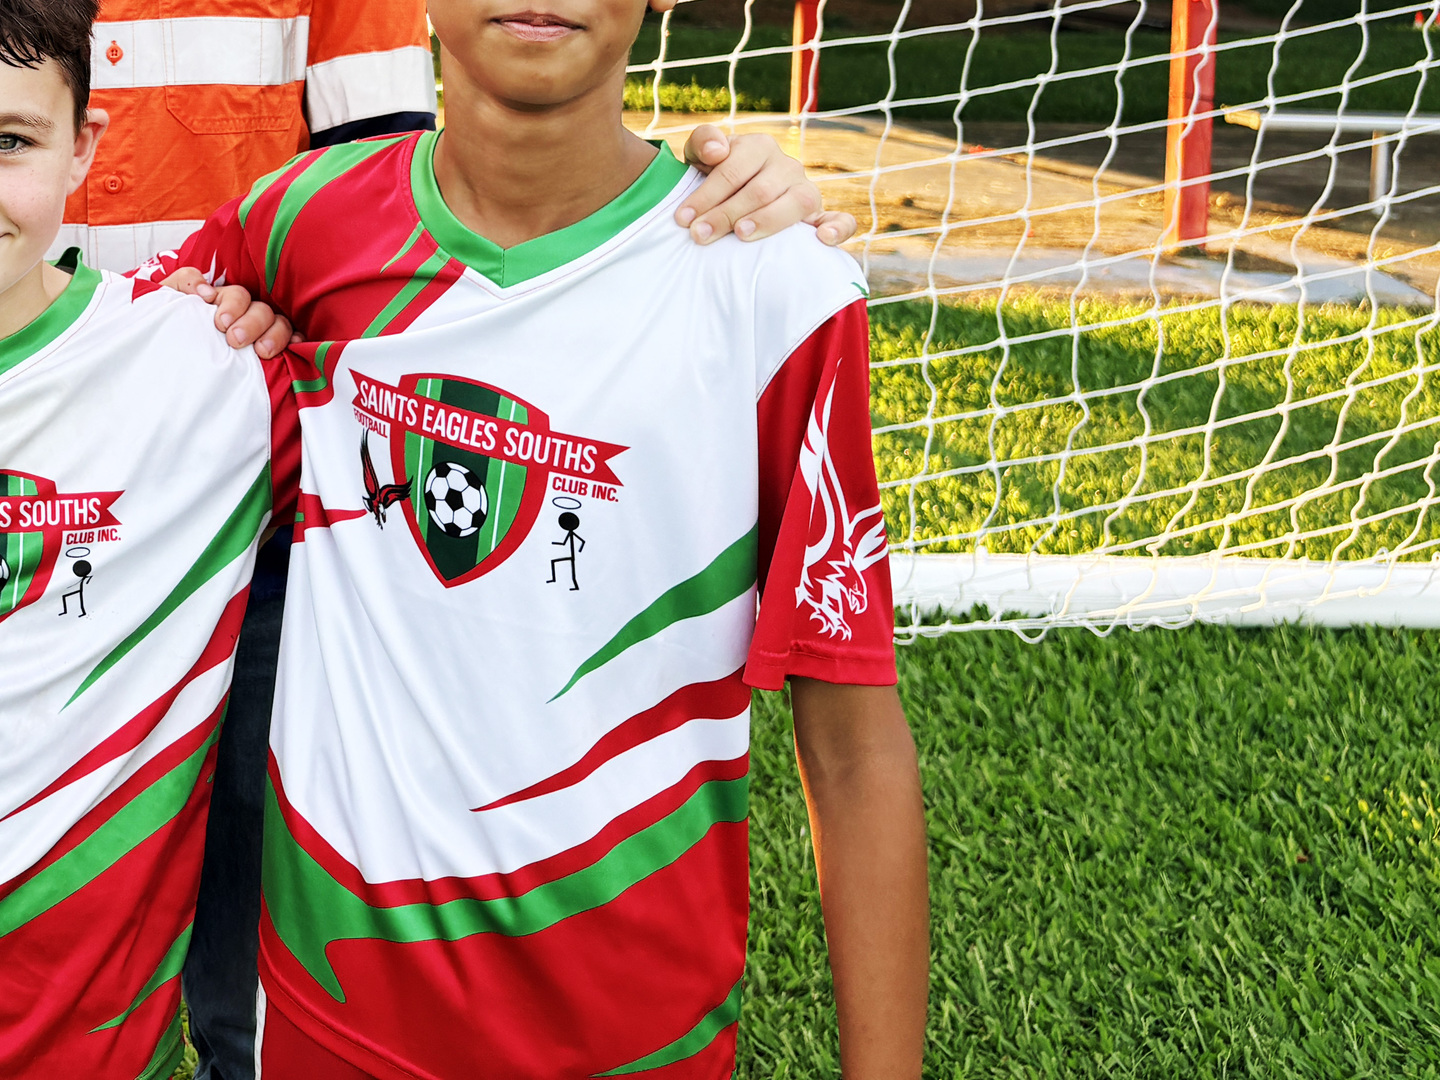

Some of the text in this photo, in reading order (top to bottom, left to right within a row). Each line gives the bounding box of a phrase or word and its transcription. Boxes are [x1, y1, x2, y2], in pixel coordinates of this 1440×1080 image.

[353, 407, 388, 439] FOOTBALL
[360, 380, 598, 475] SAINTS EAGLES SOUTHS
[552, 476, 619, 502] CLUB INC.
[19, 497, 102, 528] SOUTHS
[66, 528, 122, 545] CLUB INC.
